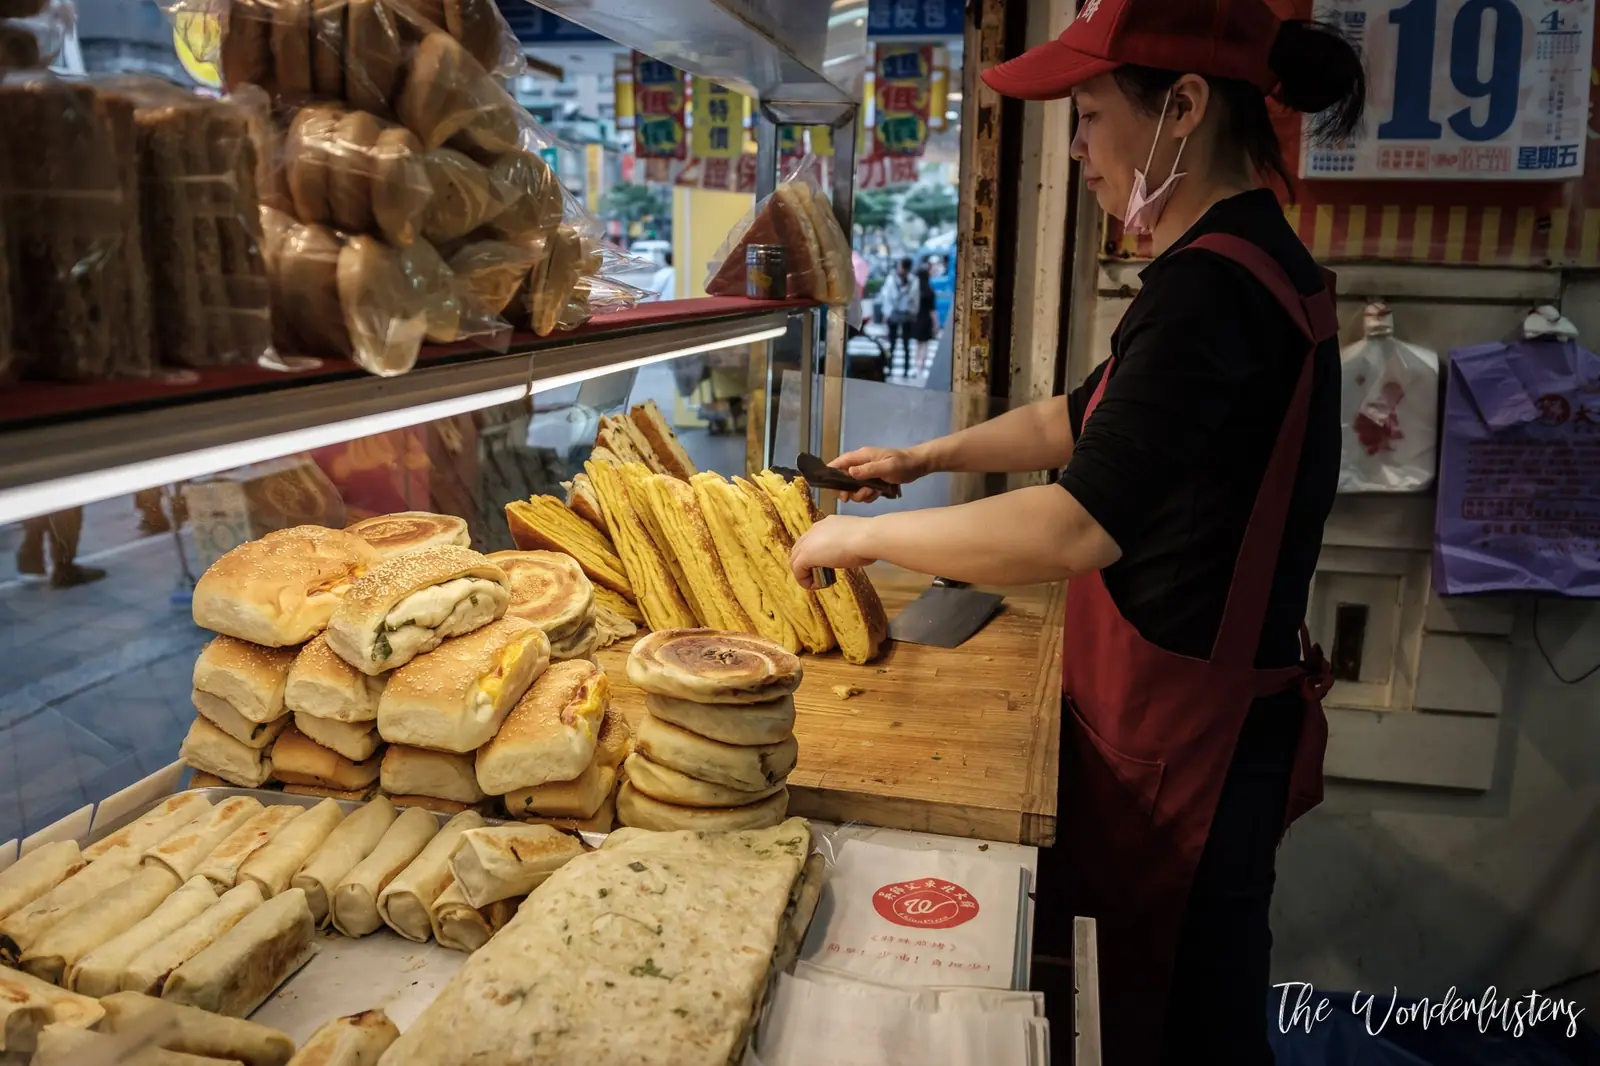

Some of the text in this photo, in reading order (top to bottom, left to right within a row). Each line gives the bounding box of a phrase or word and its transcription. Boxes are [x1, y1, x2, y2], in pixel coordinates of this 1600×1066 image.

[1540, 9, 1565, 31] 4
[1377, 0, 1523, 141] 19
[1516, 144, 1580, 170] 星期五
